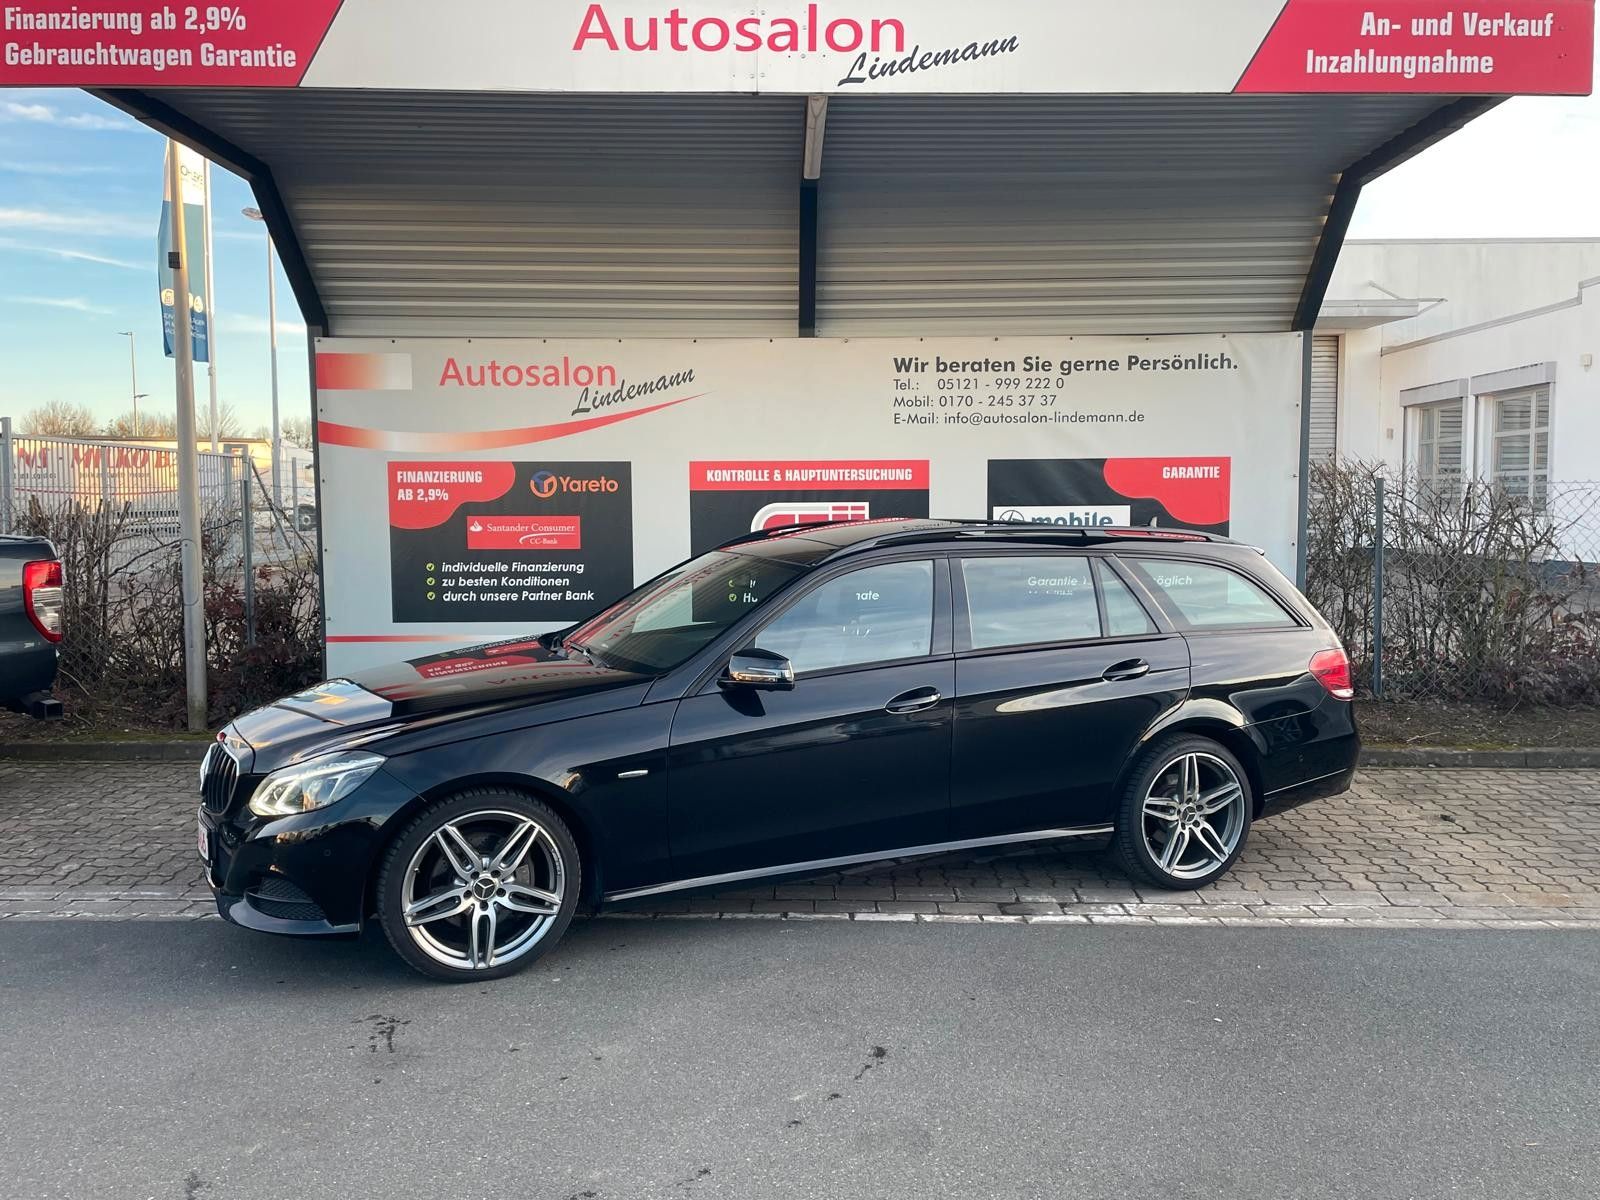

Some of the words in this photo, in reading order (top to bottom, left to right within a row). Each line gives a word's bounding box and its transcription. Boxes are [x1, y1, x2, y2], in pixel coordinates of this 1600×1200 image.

[4, 6, 142, 35] Finanzierung
[150, 7, 176, 30] ab
[184, 6, 247, 34] 2,9%
[572, 3, 905, 52] Autosalon
[1360, 12, 1402, 36] An-
[1411, 12, 1452, 36] und
[1463, 12, 1553, 37] Verkauf
[5, 42, 193, 71] Gebrauchtwagen
[200, 42, 297, 68] Garantie
[836, 34, 1019, 87] Lindemann
[1306, 49, 1493, 79] Inzahlungnahme
[439, 356, 617, 387] Autosalon
[893, 356, 929, 373] Wir
[936, 356, 1016, 373] beraten
[1022, 355, 1053, 372] Sie
[1059, 357, 1120, 376] gerne
[1127, 353, 1239, 371] Persönlich.
[893, 378, 920, 391] Tel.:
[937, 378, 980, 390] 05121
[995, 378, 1020, 390] 999
[1025, 378, 1051, 390] 222
[1056, 377, 1064, 389] 0
[571, 368, 696, 416] Lindemann
[893, 394, 934, 408] Mobil:
[939, 395, 973, 407] 0170
[988, 395, 1014, 407] 245
[1018, 395, 1036, 407] 37
[1040, 395, 1057, 407] 37
[893, 412, 939, 425] E-Mail:
[943, 410, 1145, 426] info@autosalon-lindemann.de
[397, 470, 483, 484] FINANZIERUNG
[706, 469, 770, 482] KONTROLLE
[773, 469, 782, 481] &
[785, 468, 913, 481] HAUPTUNTERSUCHUNG
[1162, 466, 1221, 479] GARANTIE
[560, 476, 619, 493] Yareto
[397, 488, 413, 501] AB
[416, 488, 449, 503] 2,9%
[1031, 511, 1114, 527] mobile
[487, 523, 529, 532] Santander
[530, 523, 576, 532] Consumer
[441, 562, 508, 573] individuelle
[511, 562, 585, 574] Finanzierung
[442, 577, 456, 587] zu
[458, 575, 498, 587] besten
[501, 575, 570, 587] Konditionen
[1028, 575, 1078, 587] Garantie
[1153, 575, 1193, 588] öglich
[443, 590, 477, 602] durch
[480, 592, 518, 602] unsere
[521, 589, 563, 602] Partner
[566, 589, 595, 601] Bank
